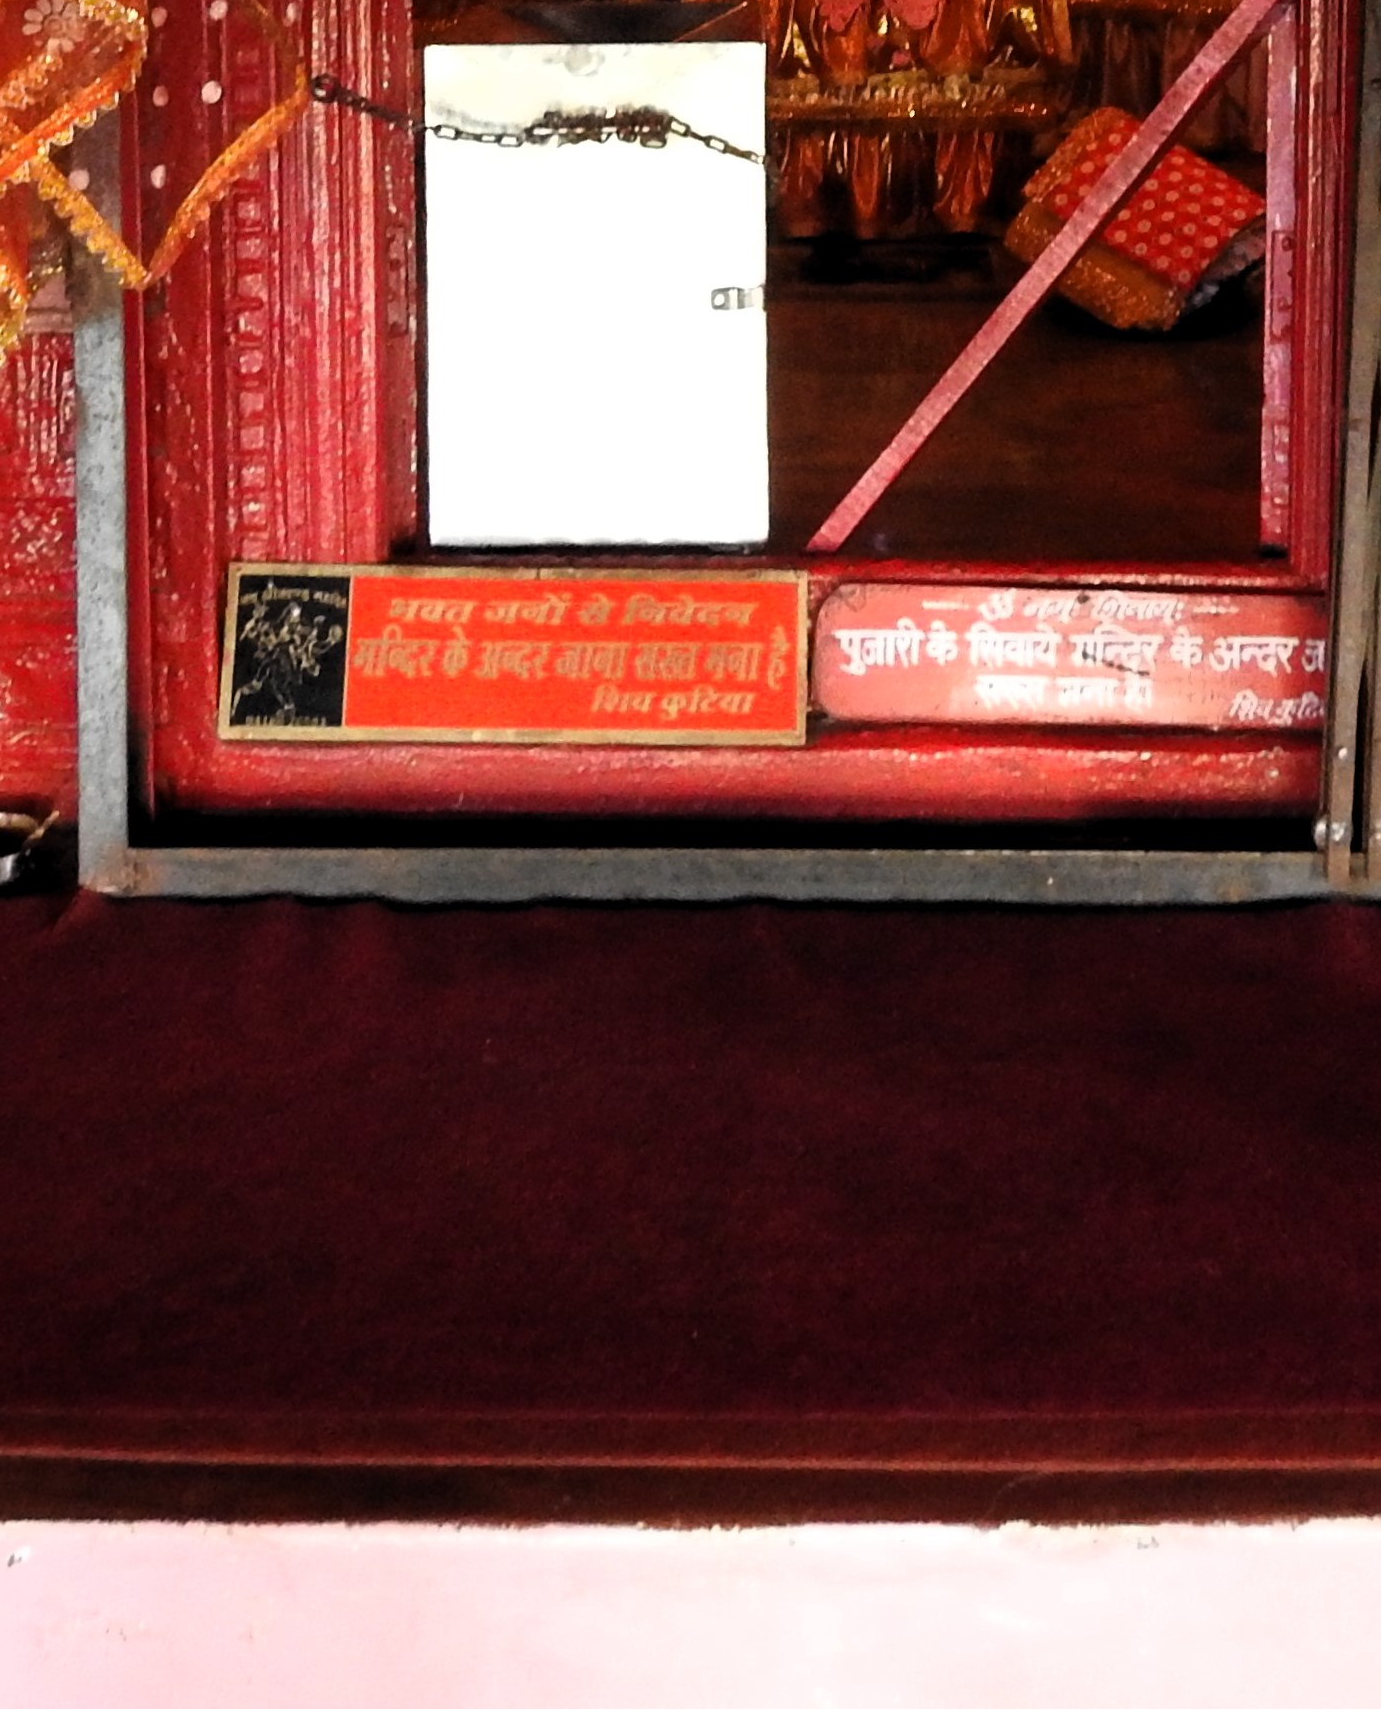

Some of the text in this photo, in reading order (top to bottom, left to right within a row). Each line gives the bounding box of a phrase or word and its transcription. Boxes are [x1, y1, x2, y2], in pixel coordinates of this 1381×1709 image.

[619, 593, 760, 627] निवेदन
[833, 616, 925, 674] पुजारी
[926, 620, 958, 667] के
[1170, 626, 1204, 668] के
[1208, 636, 1300, 678] अन्दर
[1268, 690, 1325, 726] कुटि
